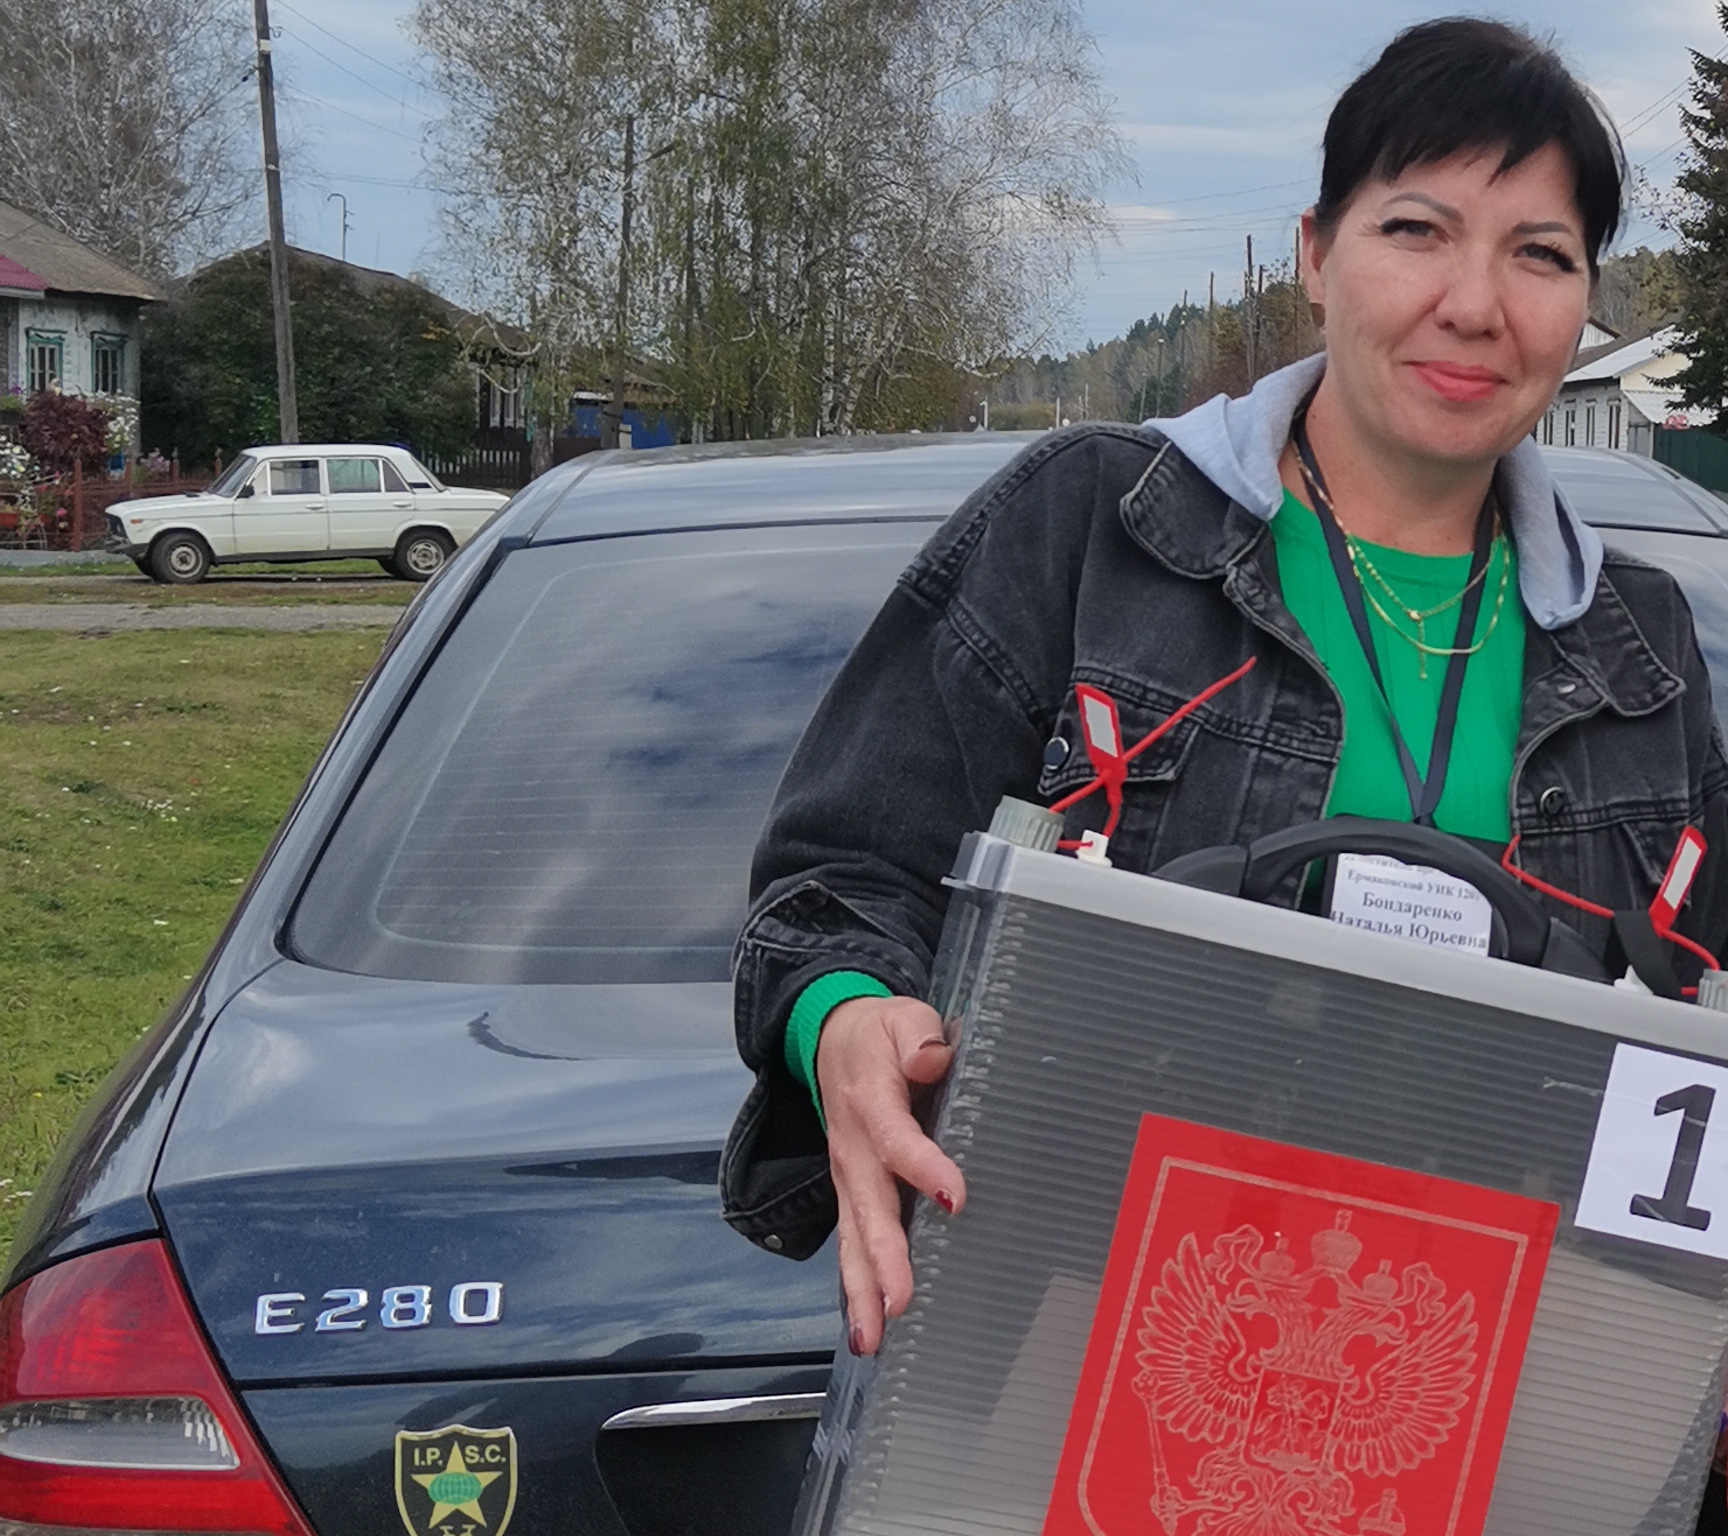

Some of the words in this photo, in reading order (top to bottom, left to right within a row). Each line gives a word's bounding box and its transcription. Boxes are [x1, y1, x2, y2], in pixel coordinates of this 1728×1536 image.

[1346, 869, 1424, 891] Ермаковской
[1426, 882, 1456, 897] УИК
[1361, 891, 1463, 922] Бондаренко
[1330, 909, 1403, 936] Наталья
[1408, 923, 1487, 949] Юрьевна
[1629, 1083, 1717, 1232] 1
[254, 1281, 504, 1335] E280
